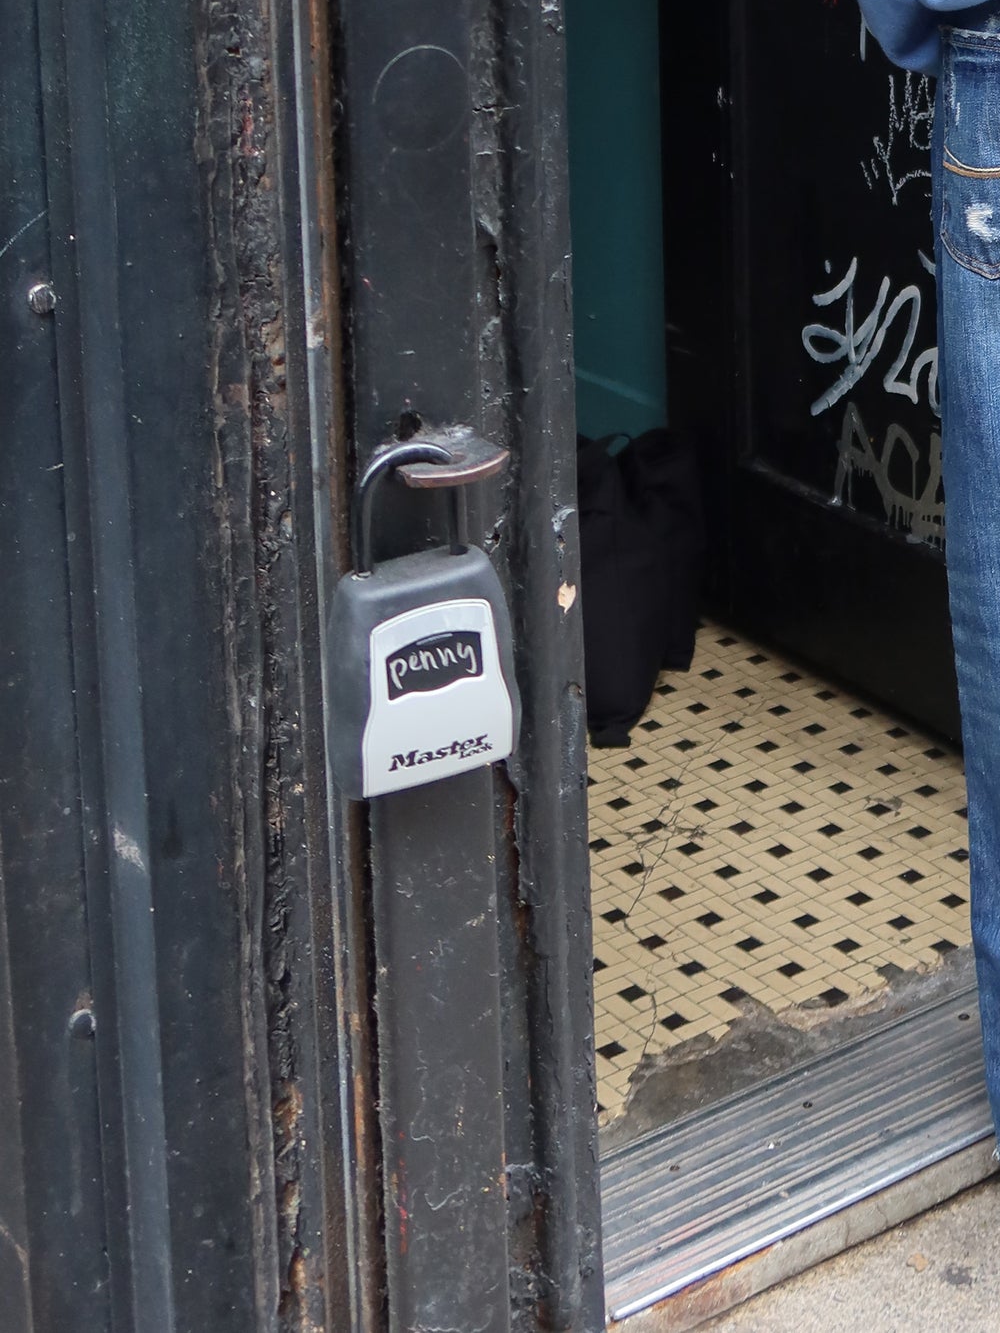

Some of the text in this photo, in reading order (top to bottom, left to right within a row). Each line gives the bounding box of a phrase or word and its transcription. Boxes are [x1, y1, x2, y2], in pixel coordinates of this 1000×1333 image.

[389, 641, 477, 689] penny
[388, 734, 488, 772] Master
[459, 742, 493, 759] Lock
